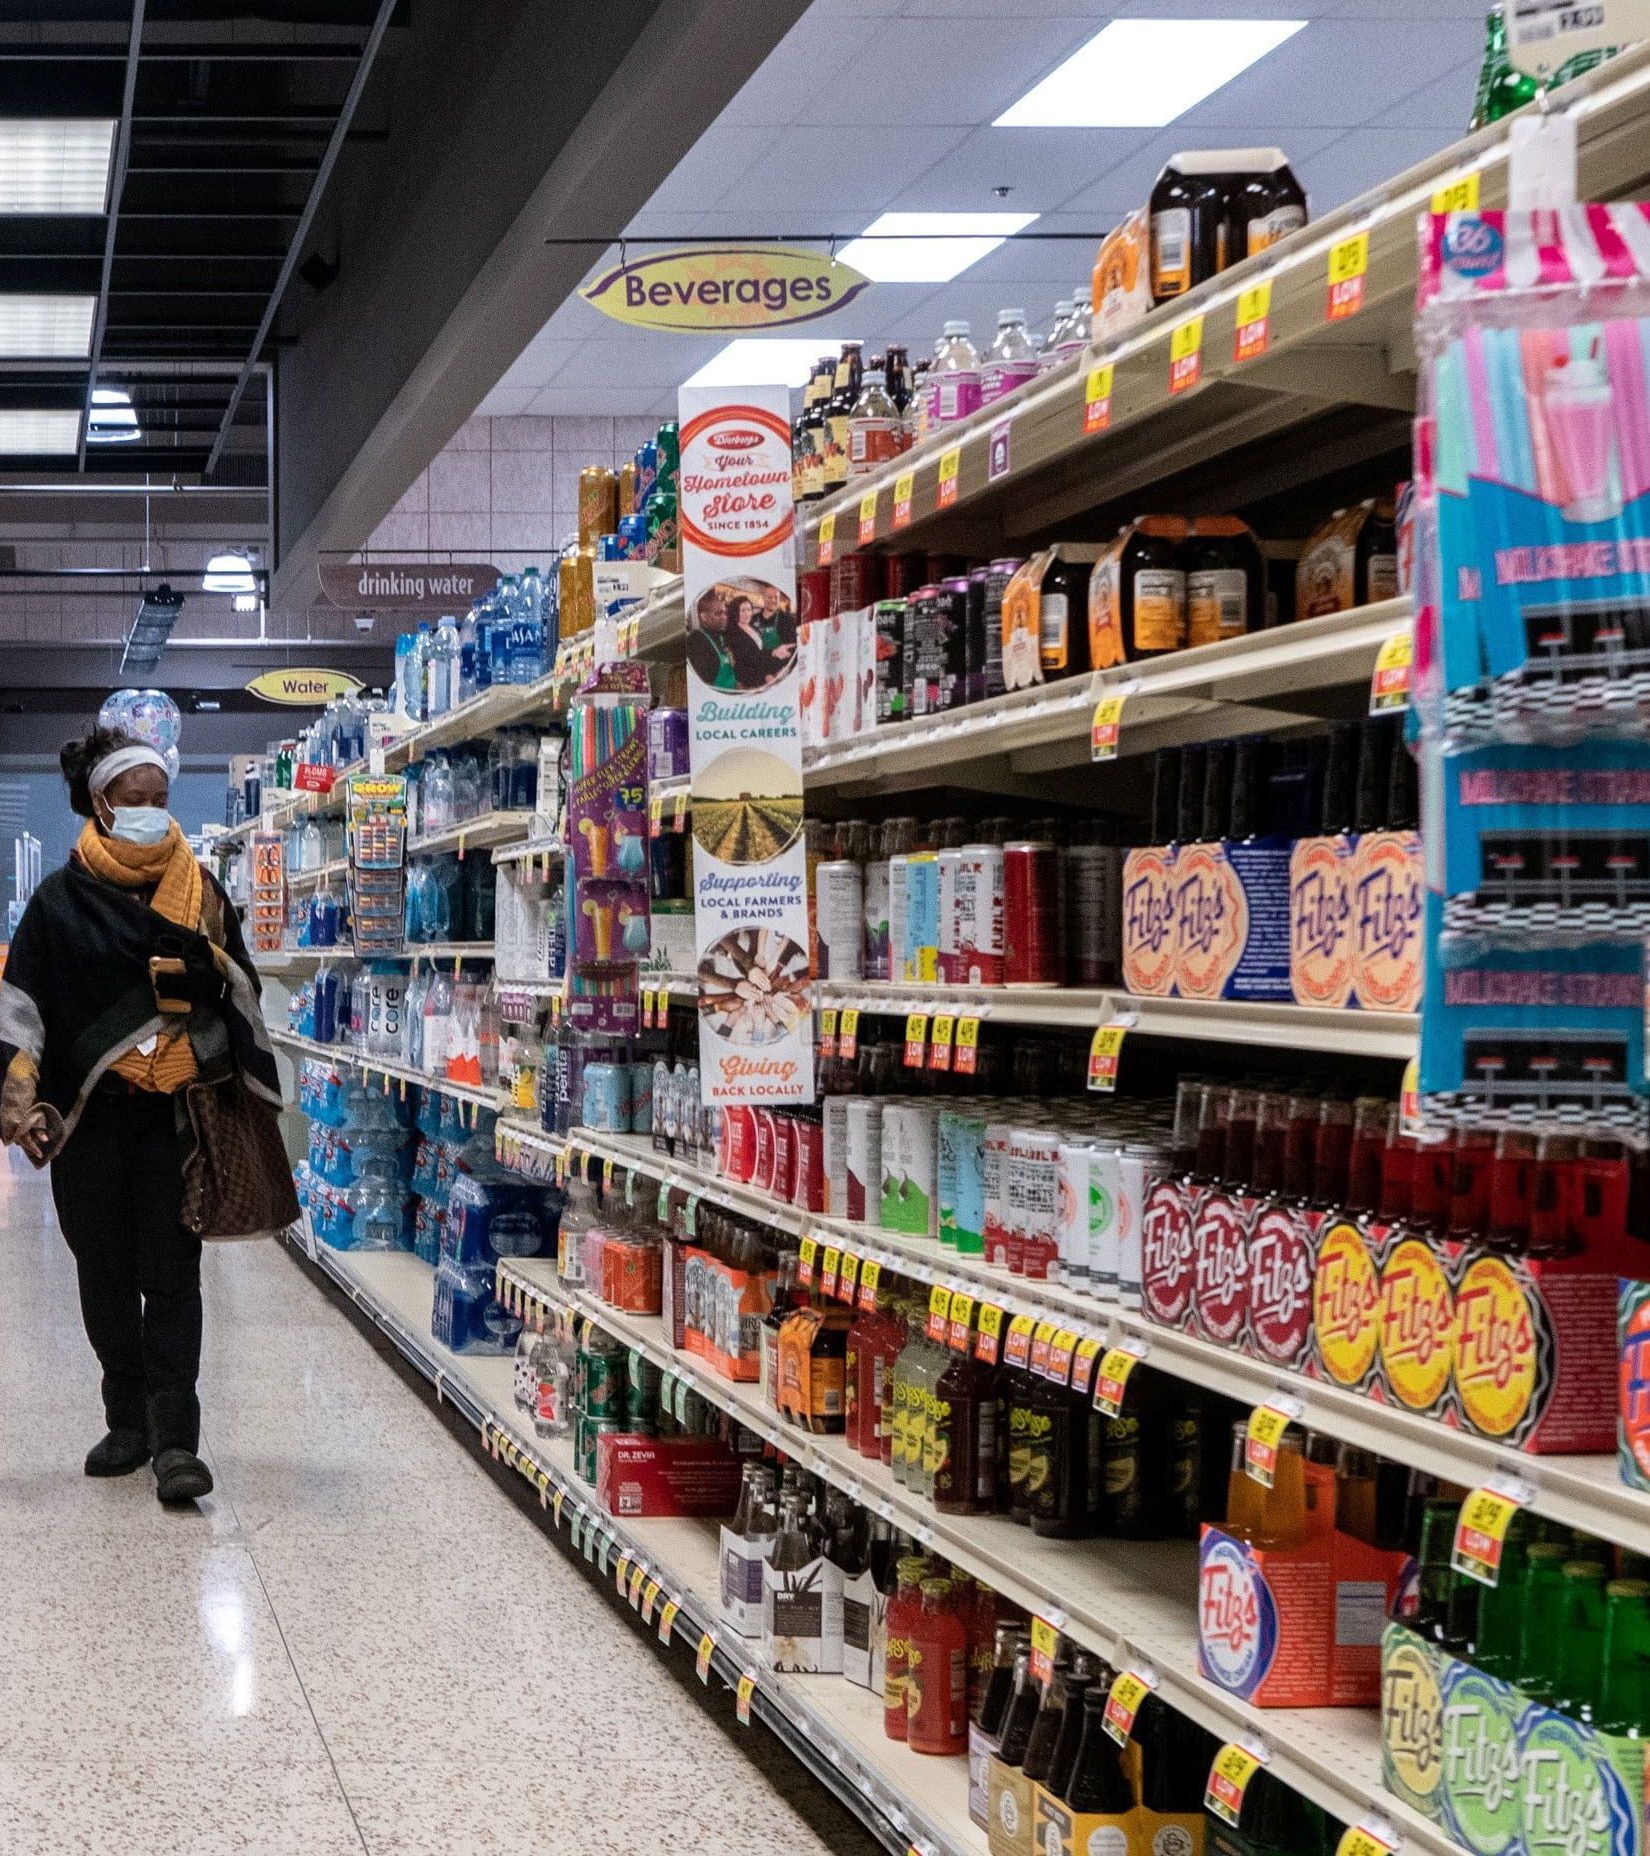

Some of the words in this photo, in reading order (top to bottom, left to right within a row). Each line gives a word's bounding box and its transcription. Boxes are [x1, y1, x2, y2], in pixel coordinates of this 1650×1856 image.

[625, 275, 832, 311] Beverages
[714, 454, 754, 472] Your
[684, 470, 790, 493] Hometown
[703, 493, 776, 522] Store
[707, 521, 741, 531] SINCE
[744, 520, 769, 530] 1854
[358, 572, 424, 598] drinking
[428, 575, 474, 595] water
[283, 678, 328, 694] Water
[697, 701, 795, 725] Building
[696, 729, 737, 740] LOCAL
[740, 727, 797, 739] CAREERS
[700, 872, 802, 893] Supporting
[701, 898, 740, 908] LOCAL
[744, 896, 802, 907] FARMERS
[720, 908, 729, 919] &
[732, 908, 783, 919] BRANDS
[1127, 876, 1174, 953] Fitz's
[1177, 874, 1223, 953] Fitz's
[1295, 870, 1349, 960] Fitz's
[1356, 867, 1423, 960] Fitz's
[385, 987, 399, 1034] core
[907, 1044, 923, 1056] LOW
[957, 1047, 974, 1061] LOW
[719, 1055, 798, 1083] Giving
[712, 1086, 745, 1096] BACK
[749, 1084, 804, 1096] LOCALLY
[1143, 1203, 1192, 1287] Fitz's
[1195, 1219, 1247, 1305] Fitz's
[1250, 1232, 1309, 1322] Fitz's
[1317, 1252, 1378, 1342] Fitz's
[1382, 1269, 1452, 1365] Fitz's
[979, 1333, 996, 1350] LOW
[1008, 1332, 1027, 1347] LOW
[1457, 1286, 1530, 1389] Fitz's
[1202, 1564, 1257, 1650] Fitz's
[1443, 1705, 1521, 1812] Fitz's
[1521, 1750, 1610, 1856] Fitz's
